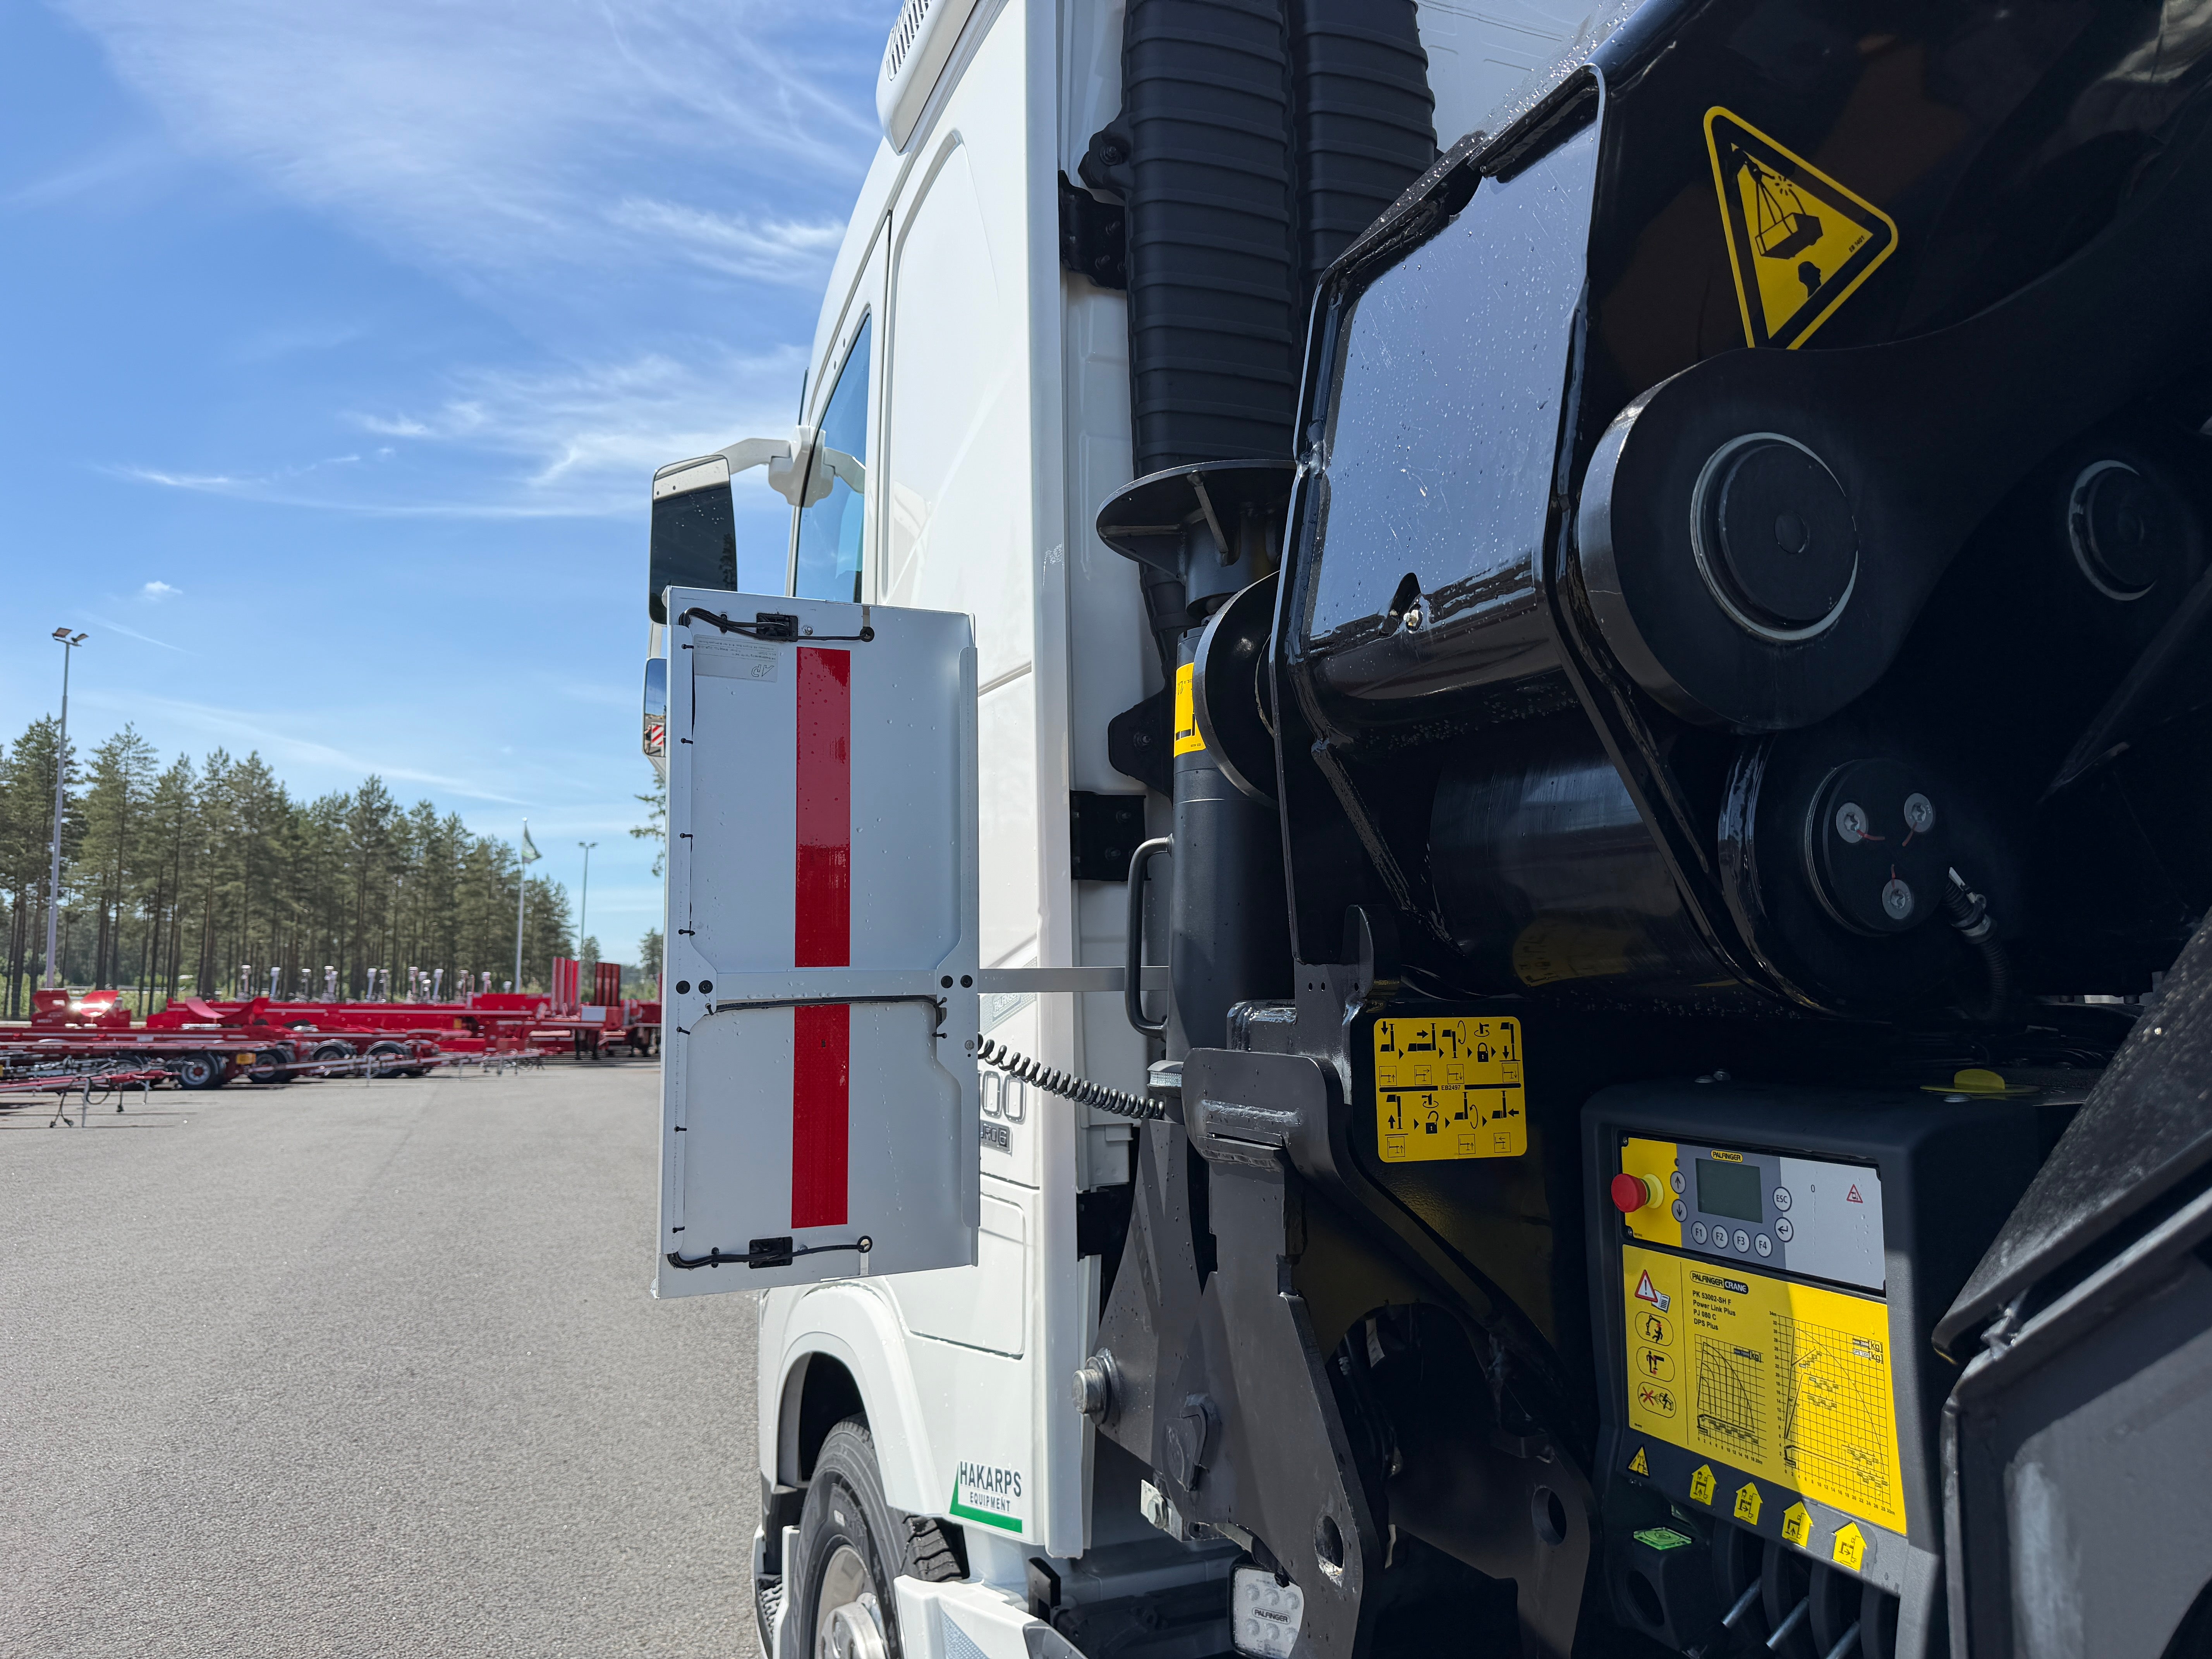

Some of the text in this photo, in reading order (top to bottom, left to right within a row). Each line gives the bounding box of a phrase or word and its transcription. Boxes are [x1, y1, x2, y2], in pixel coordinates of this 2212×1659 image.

[1855, 235, 1865, 246] 1401
[978, 1070, 1026, 1125] 00
[1713, 1151, 1741, 1161] PALFINGER
[1776, 1194, 1788, 1203] ESC
[1695, 1228, 1703, 1237] F1
[1716, 1232, 1723, 1241] F2
[1737, 1236, 1745, 1245] F3
[1759, 1240, 1767, 1250] F4
[1692, 1273, 1747, 1292] PALFINGER CRANE
[1702, 1293, 1726, 1304] 53002-SH
[1693, 1300, 1736, 1316] Power Link Plus
[1707, 1321, 1718, 1330] Plus
[959, 1461, 1022, 1498] HAKARPS
[969, 1491, 1011, 1512] EQUIPMENT
[1255, 1609, 1288, 1622] PALFINGER
